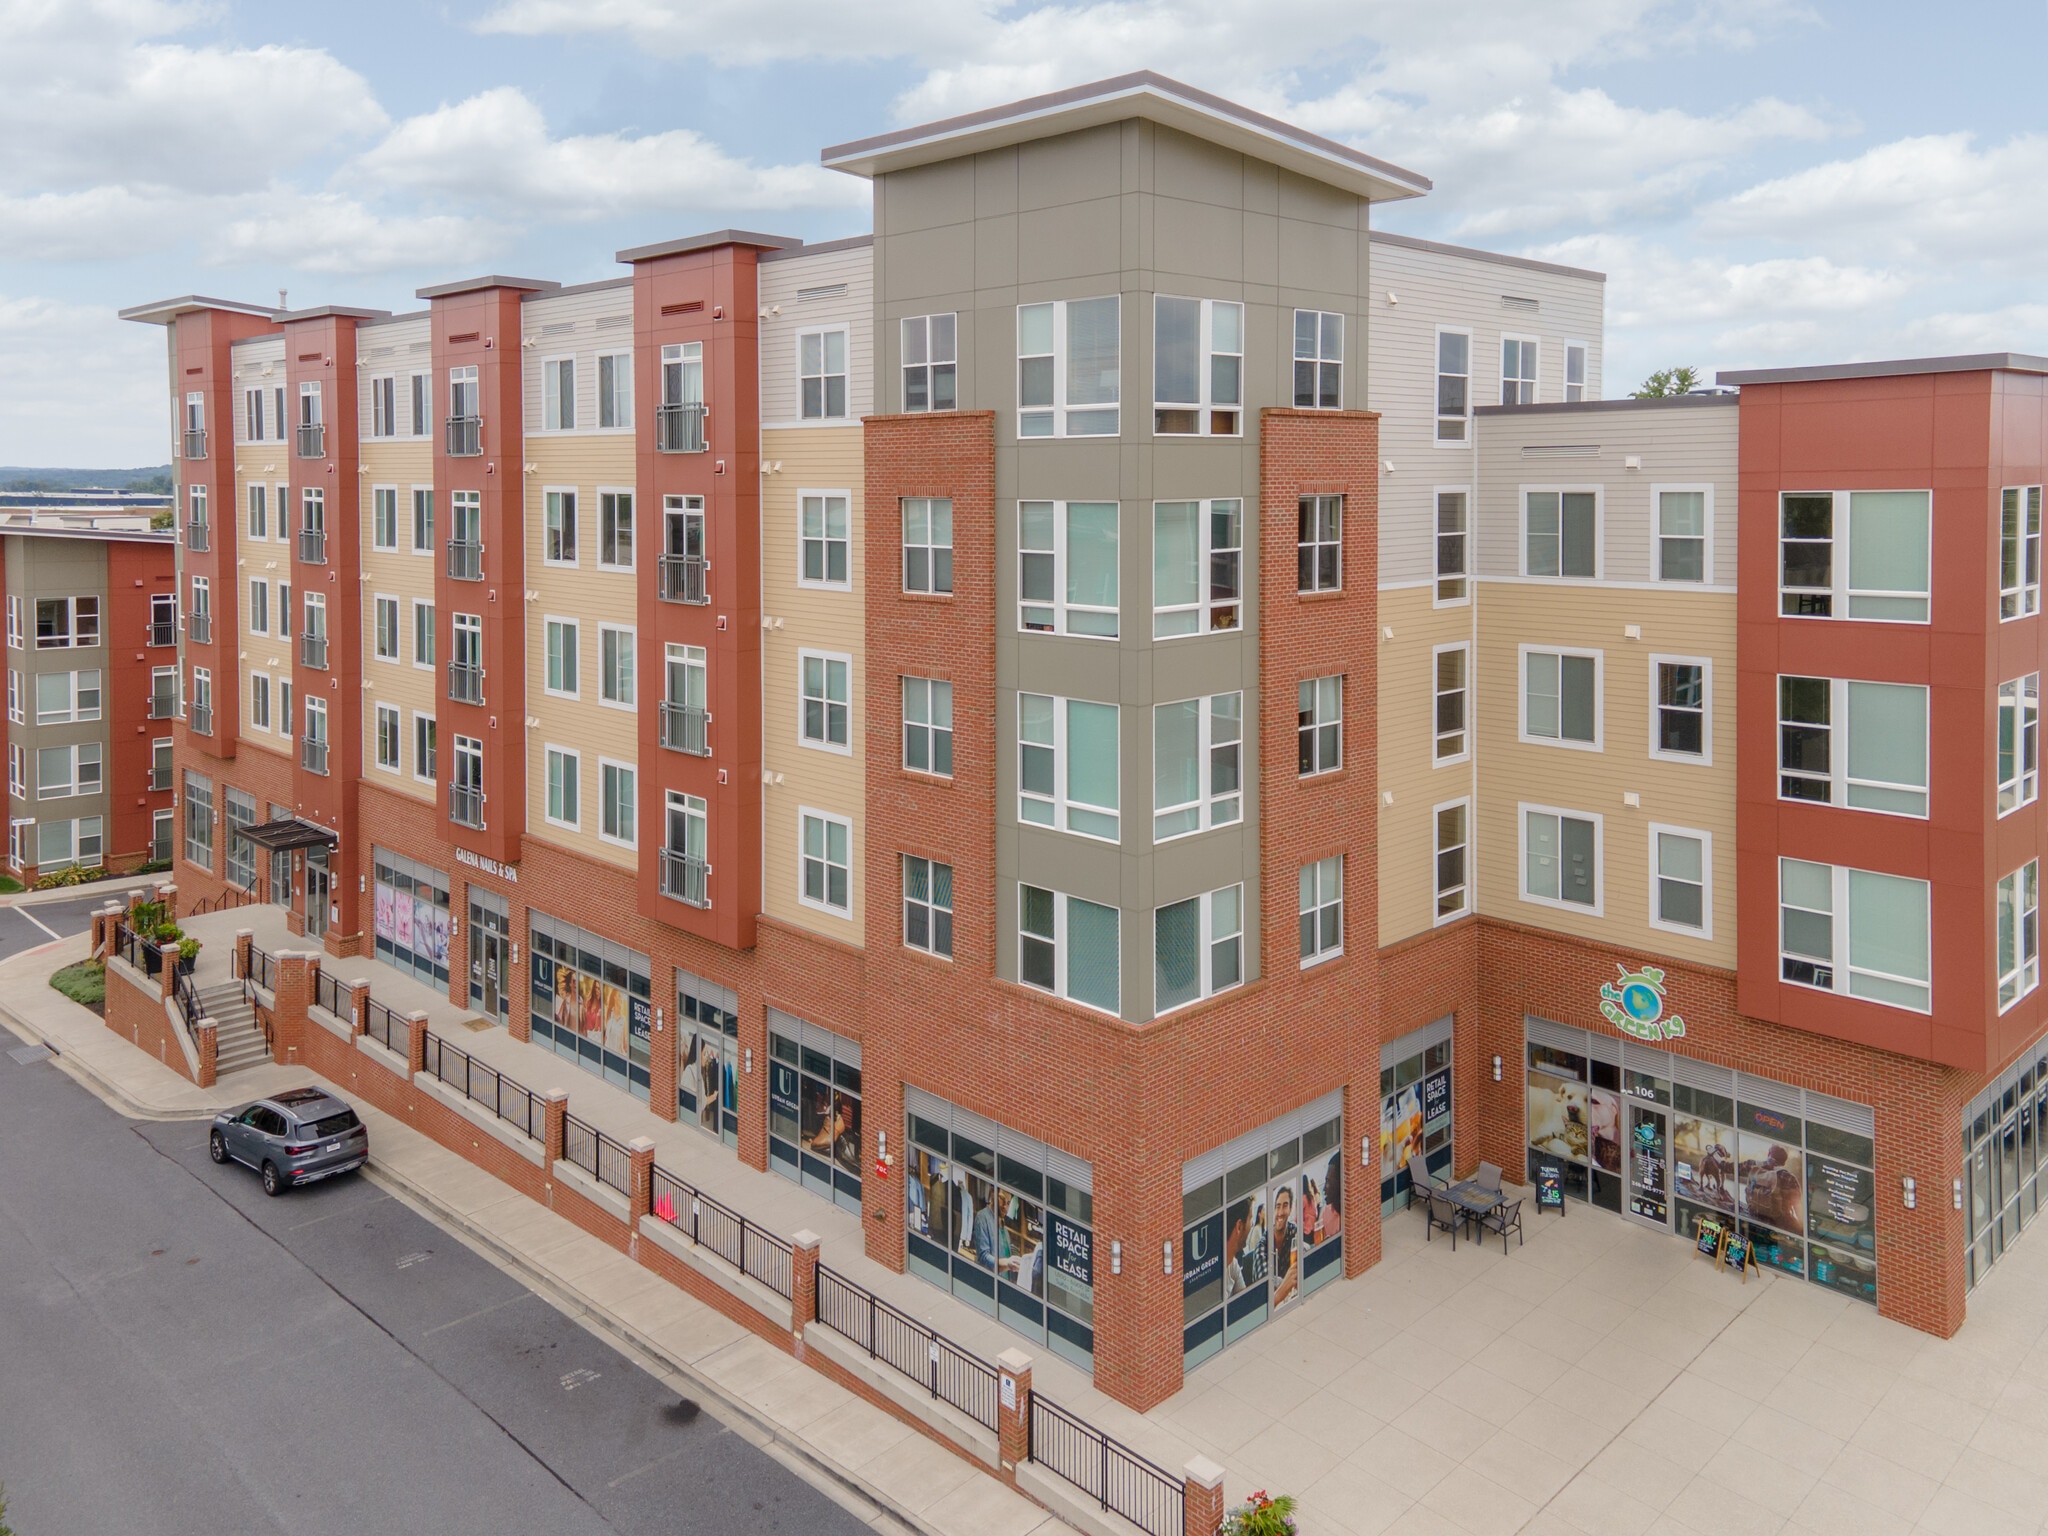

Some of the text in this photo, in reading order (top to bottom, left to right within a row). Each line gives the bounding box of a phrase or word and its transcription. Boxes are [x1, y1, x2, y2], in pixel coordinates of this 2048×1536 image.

[456, 847, 518, 882] GALENA NAILS & SPA
[1601, 983, 1622, 1001] the
[1600, 1001, 1686, 1041] GREEN K9
[1426, 1075, 1447, 1093] RETAIL
[1635, 1086, 1654, 1099] 106
[1427, 1085, 1447, 1102] SPACE
[1427, 1101, 1447, 1120] LEASE
[1755, 1112, 1785, 1130] OPEN
[1055, 1221, 1089, 1248] RETAIL
[1056, 1235, 1088, 1260] SPACE
[1067, 1252, 1077, 1262] for
[1201, 1255, 1219, 1271] GREEN
[1057, 1255, 1088, 1282] LEASE
